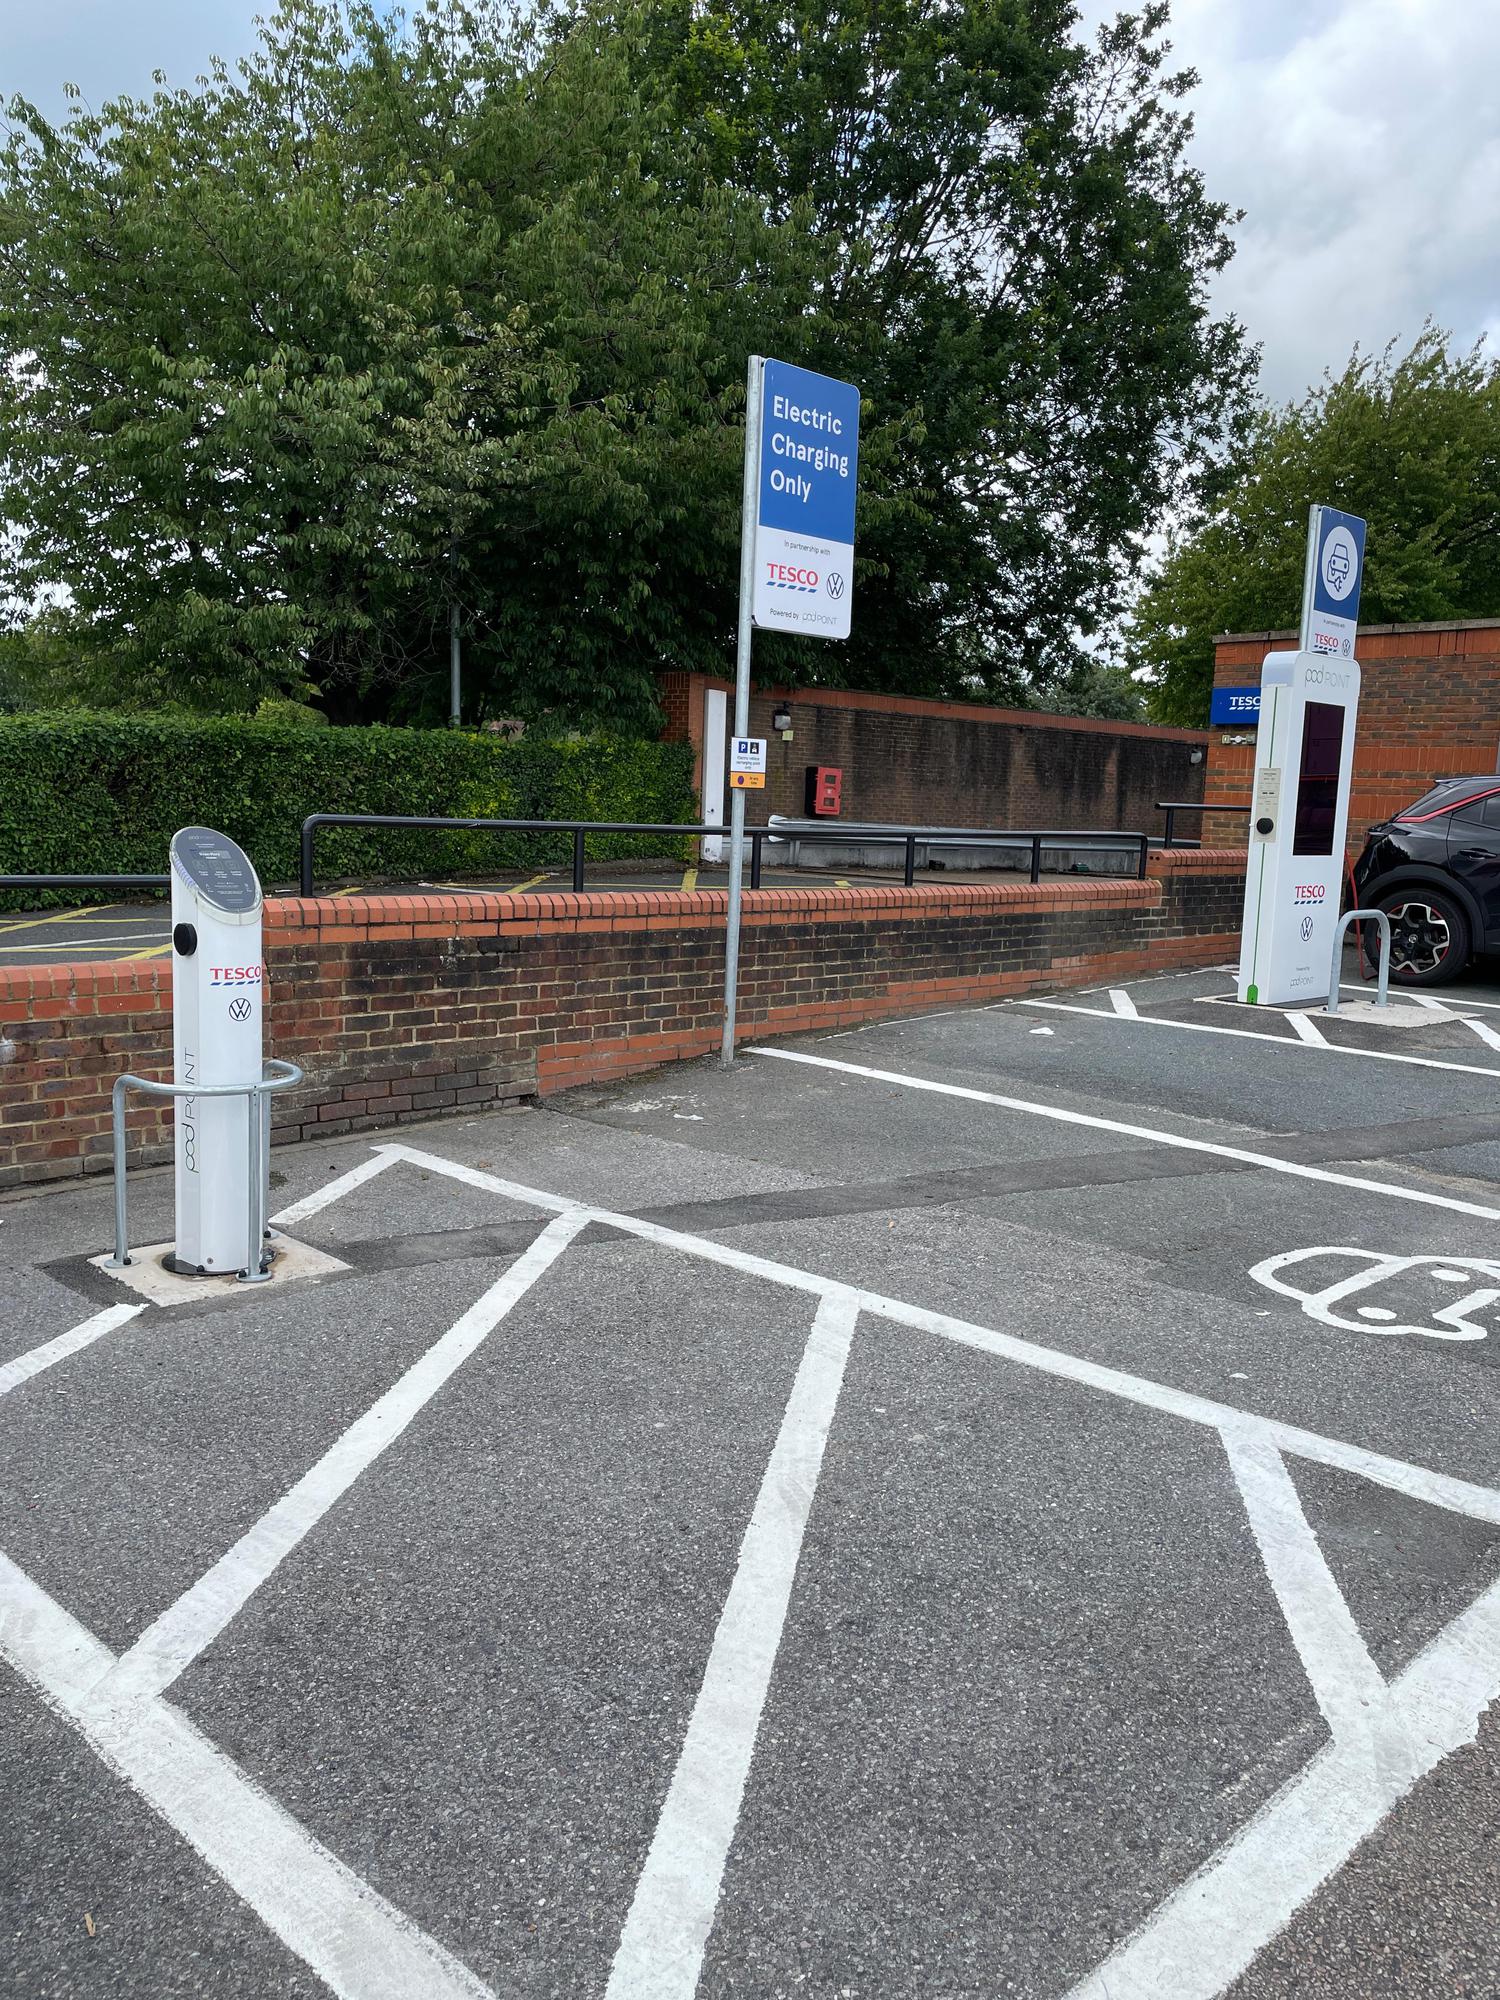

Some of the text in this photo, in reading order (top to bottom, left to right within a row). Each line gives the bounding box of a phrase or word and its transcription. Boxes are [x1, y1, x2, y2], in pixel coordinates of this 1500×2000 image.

[773, 395, 842, 435] Electric
[771, 432, 849, 478] Charging
[770, 469, 812, 503] Only
[790, 542, 820, 554] partnership
[820, 548, 831, 556] with
[767, 563, 819, 586] TESCO
[769, 608, 792, 618] Powered
[793, 612, 799, 620] by
[1315, 633, 1338, 648] TESCO
[1295, 885, 1325, 898] TESCO
[209, 965, 261, 980] TESCO
[181, 1122, 200, 1174] pod
